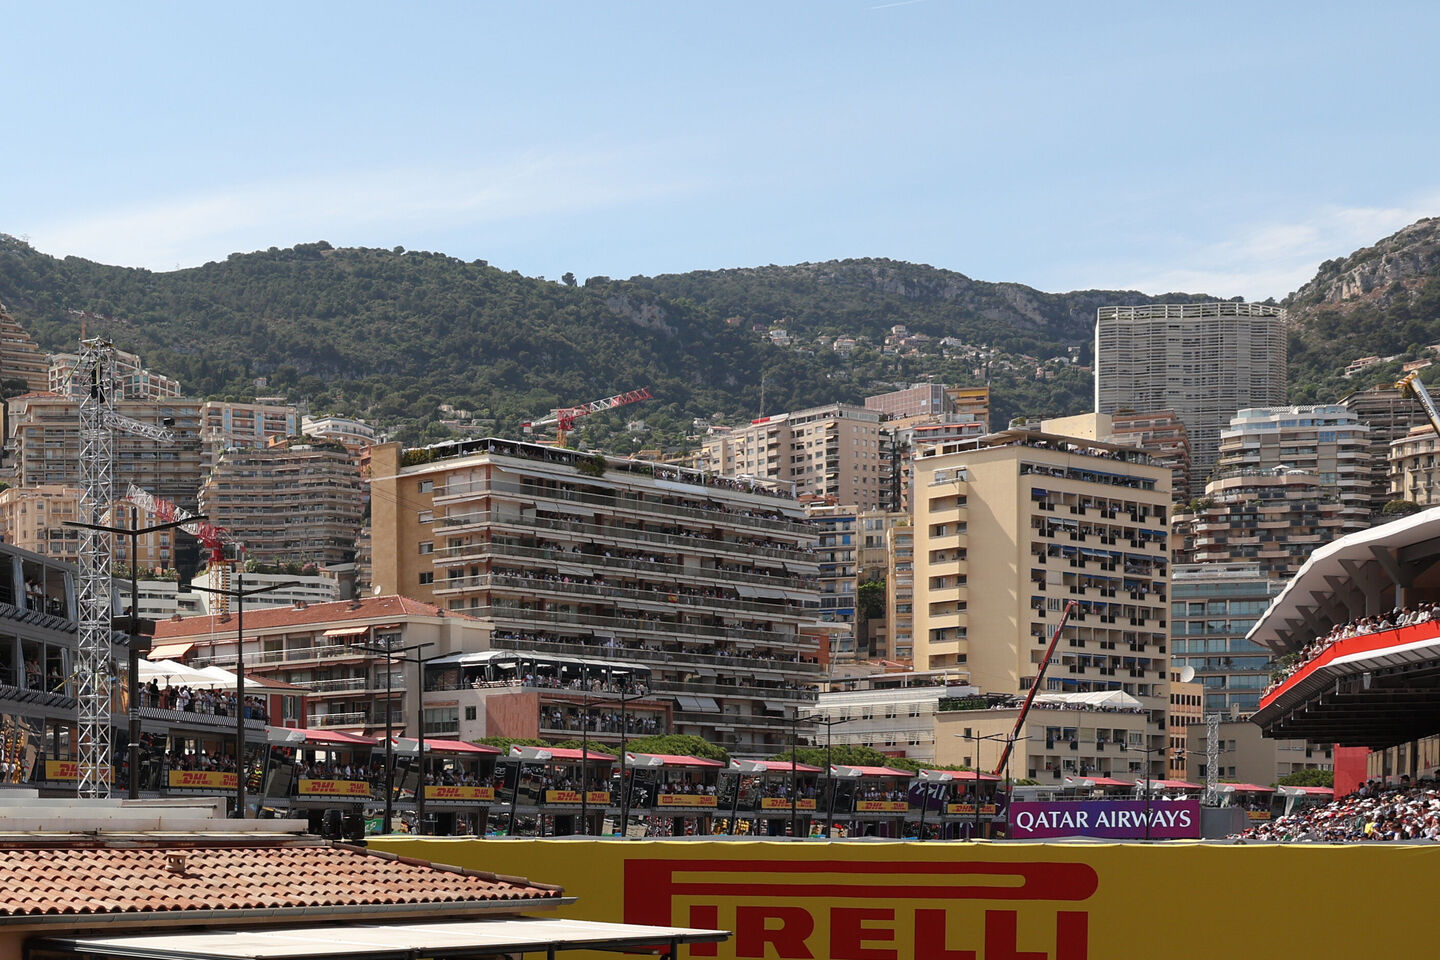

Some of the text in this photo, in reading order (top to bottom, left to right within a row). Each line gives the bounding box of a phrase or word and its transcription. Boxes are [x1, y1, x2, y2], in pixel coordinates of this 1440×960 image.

[183, 773, 208, 784] DHL
[311, 782, 335, 791] DHL
[437, 788, 461, 797] DHL
[1016, 809, 1191, 832] QATAR AIRWAYS
